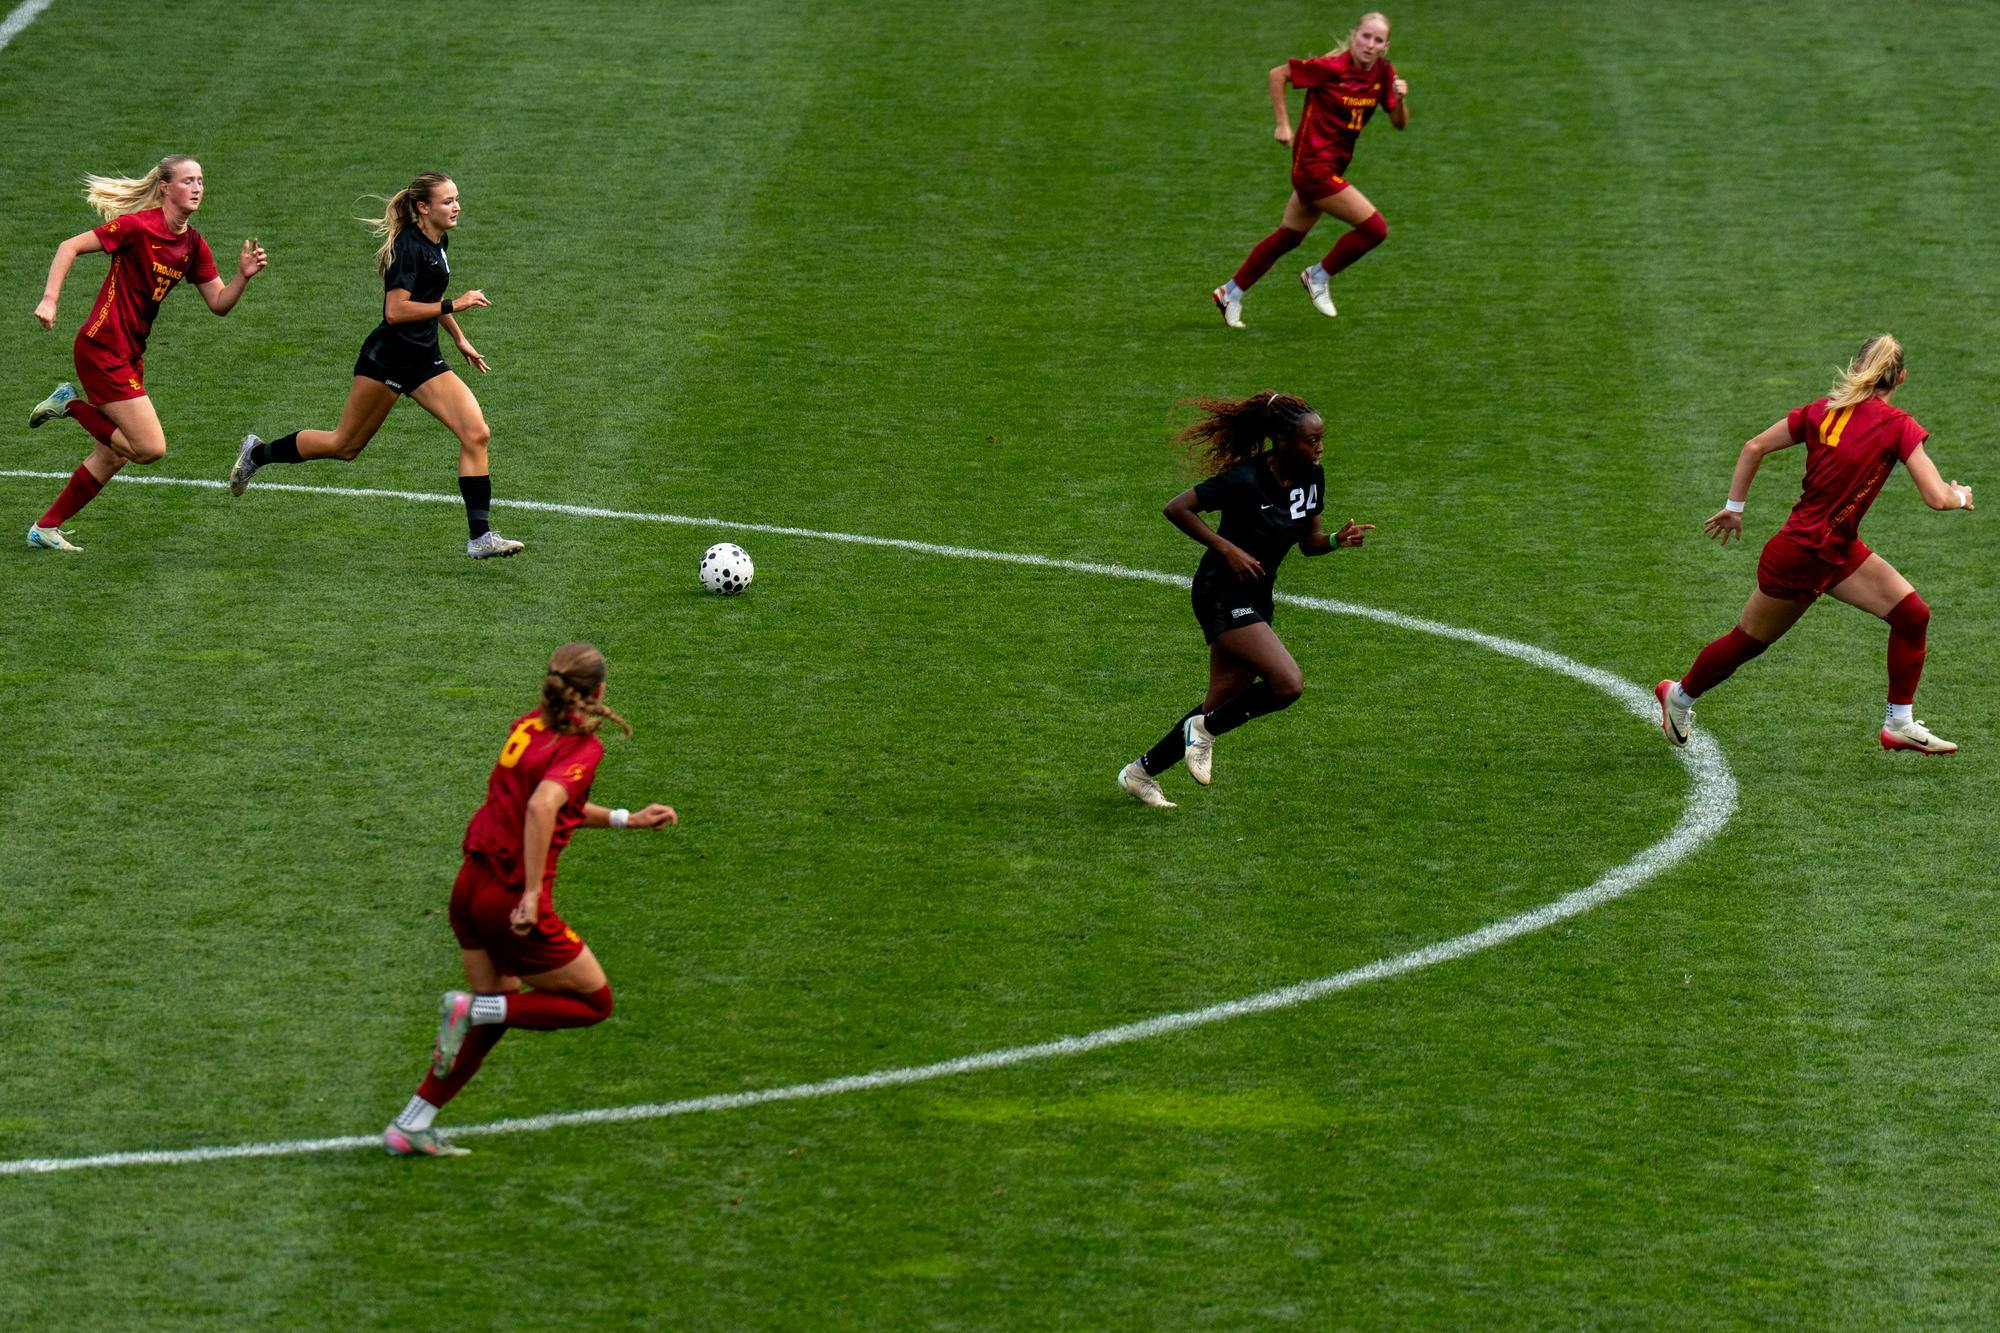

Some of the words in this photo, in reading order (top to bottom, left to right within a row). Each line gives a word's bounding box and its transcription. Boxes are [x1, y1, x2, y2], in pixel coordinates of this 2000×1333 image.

[153, 261, 182, 280] TROJANS
[1289, 483, 1318, 520] 24
[499, 717, 545, 769] 6
